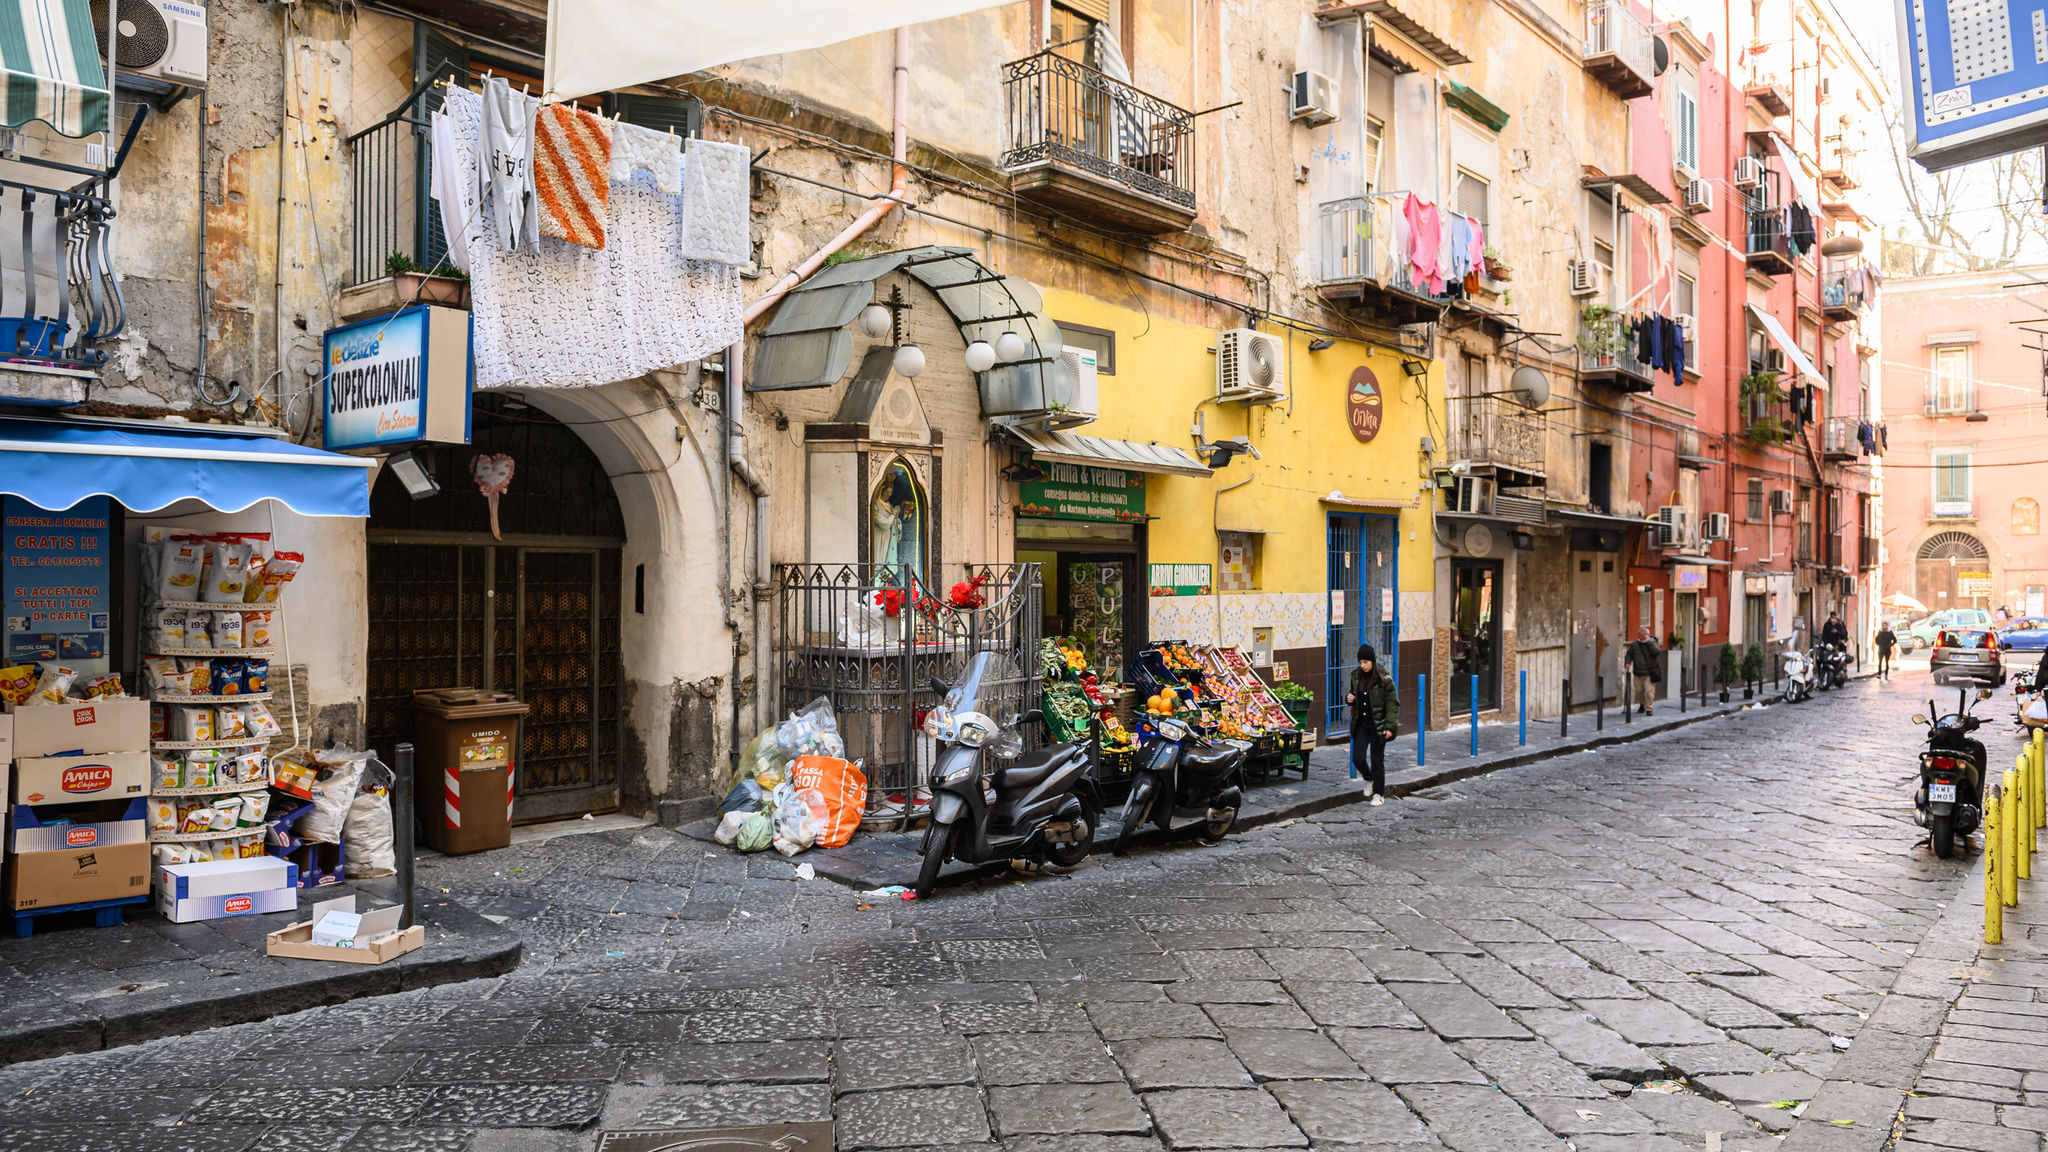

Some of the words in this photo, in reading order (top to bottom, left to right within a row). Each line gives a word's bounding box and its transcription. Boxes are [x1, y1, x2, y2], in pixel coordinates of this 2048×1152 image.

[162, 3, 201, 18] SAMSUNG
[330, 355, 421, 414] SUPERCOLONIALI
[1081, 466, 1089, 485] &
[7, 517, 54, 527] CONSEGNA
[55, 519, 62, 527] A
[64, 518, 107, 528] DOMICILIO
[16, 536, 75, 549] GRATIS
[11, 557, 35, 566] TEL.
[39, 557, 101, 566] 0813650773
[1151, 564, 1174, 587] ARRIVI
[1174, 564, 1211, 587] GIORNALIERI
[15, 587, 27, 597] SI
[31, 587, 99, 597] ACCETTANO
[23, 600, 57, 609] TUTTI
[61, 600, 65, 609] I
[70, 600, 92, 609] TIPI
[33, 612, 45, 621] DI
[49, 611, 86, 621] CARTE
[163, 618, 185, 626] 1936
[191, 621, 208, 629] 193
[221, 621, 240, 630] 1936
[64, 770, 111, 783] AMICA
[799, 767, 823, 776] PASSA
[76, 781, 98, 791] Chips
[68, 831, 95, 839] AMICA
[19, 899, 38, 907] 3197
[226, 898, 251, 907] AMICA
